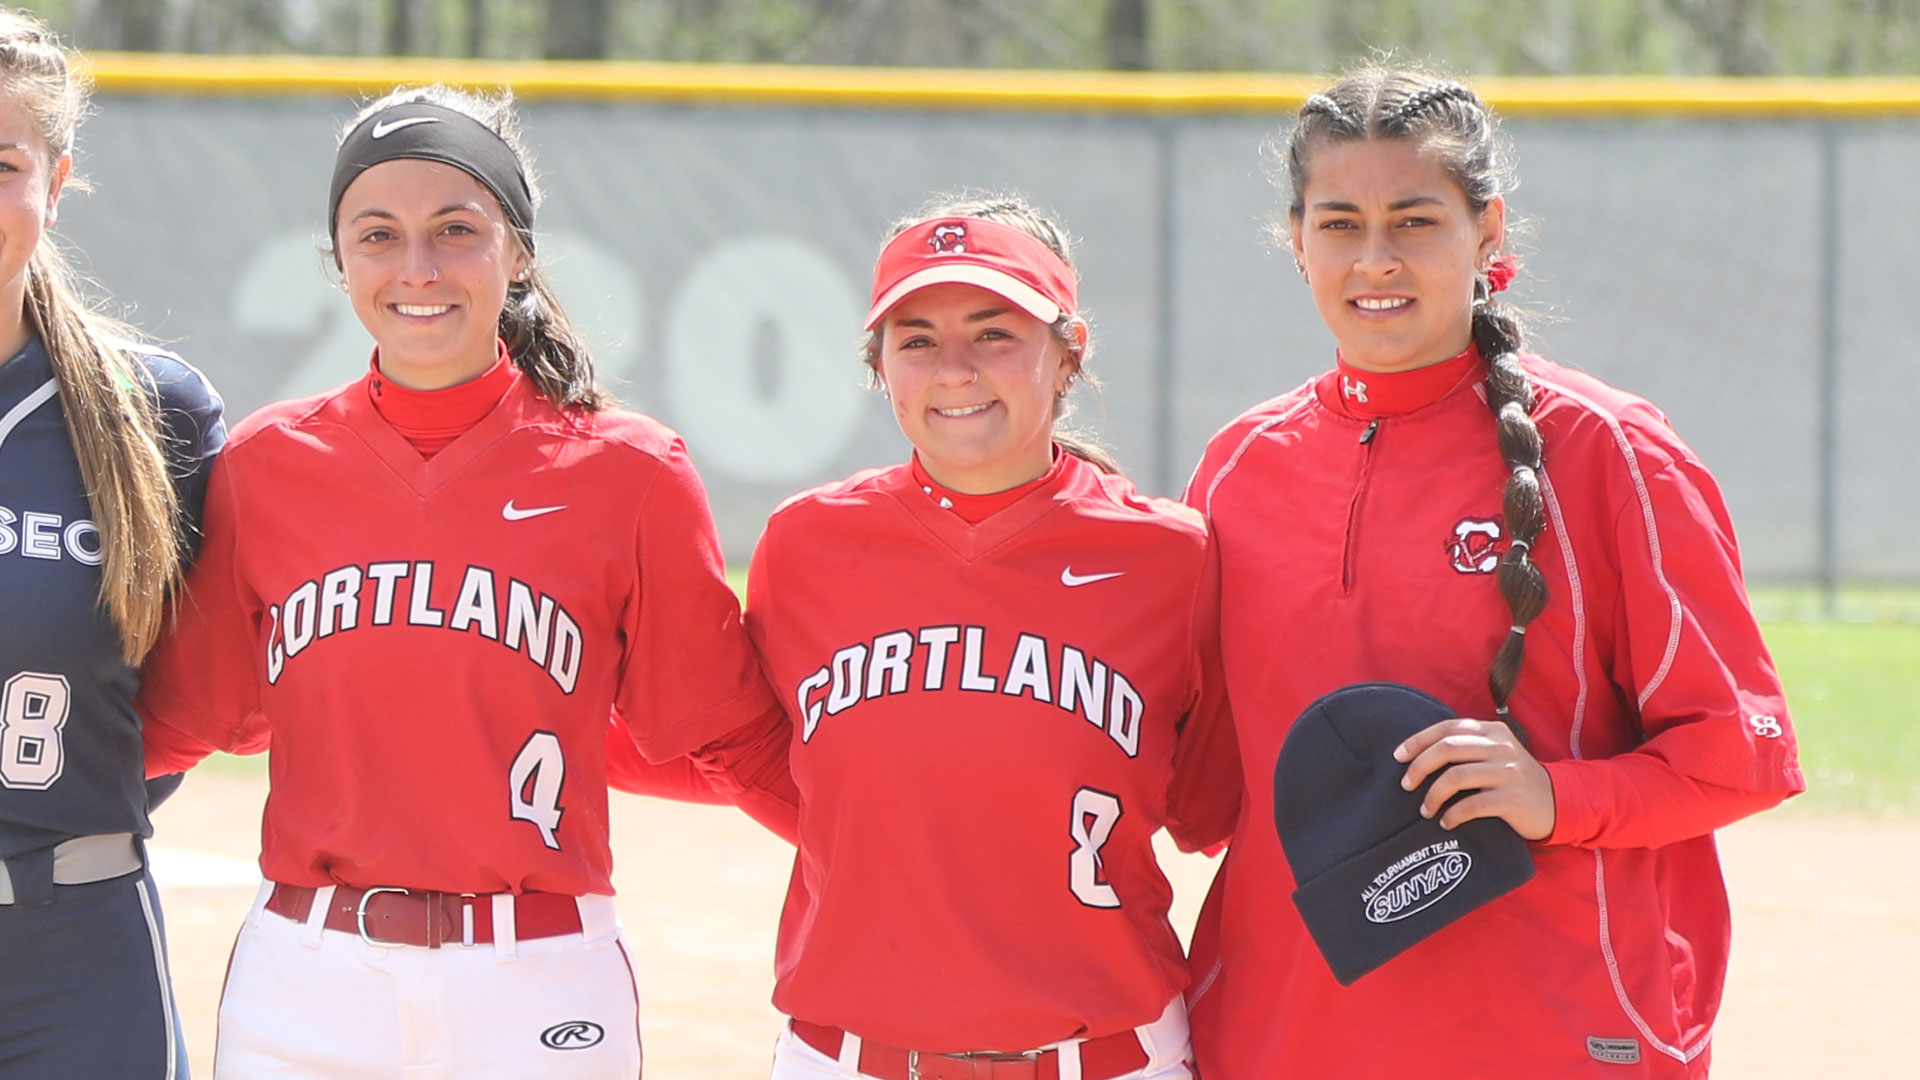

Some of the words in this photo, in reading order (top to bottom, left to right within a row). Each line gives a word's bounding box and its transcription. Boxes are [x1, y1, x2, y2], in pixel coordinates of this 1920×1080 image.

[266, 561, 584, 695] CORTLAND
[0, 671, 71, 791] 8
[797, 624, 1146, 758] CORTLAND
[509, 729, 566, 851] 4
[1068, 785, 1123, 909] 8
[1361, 885, 1378, 903] ALL
[1373, 847, 1430, 887] TOURNAMENT
[1430, 839, 1459, 854] TEAM
[1374, 855, 1463, 921] SUNYAC
